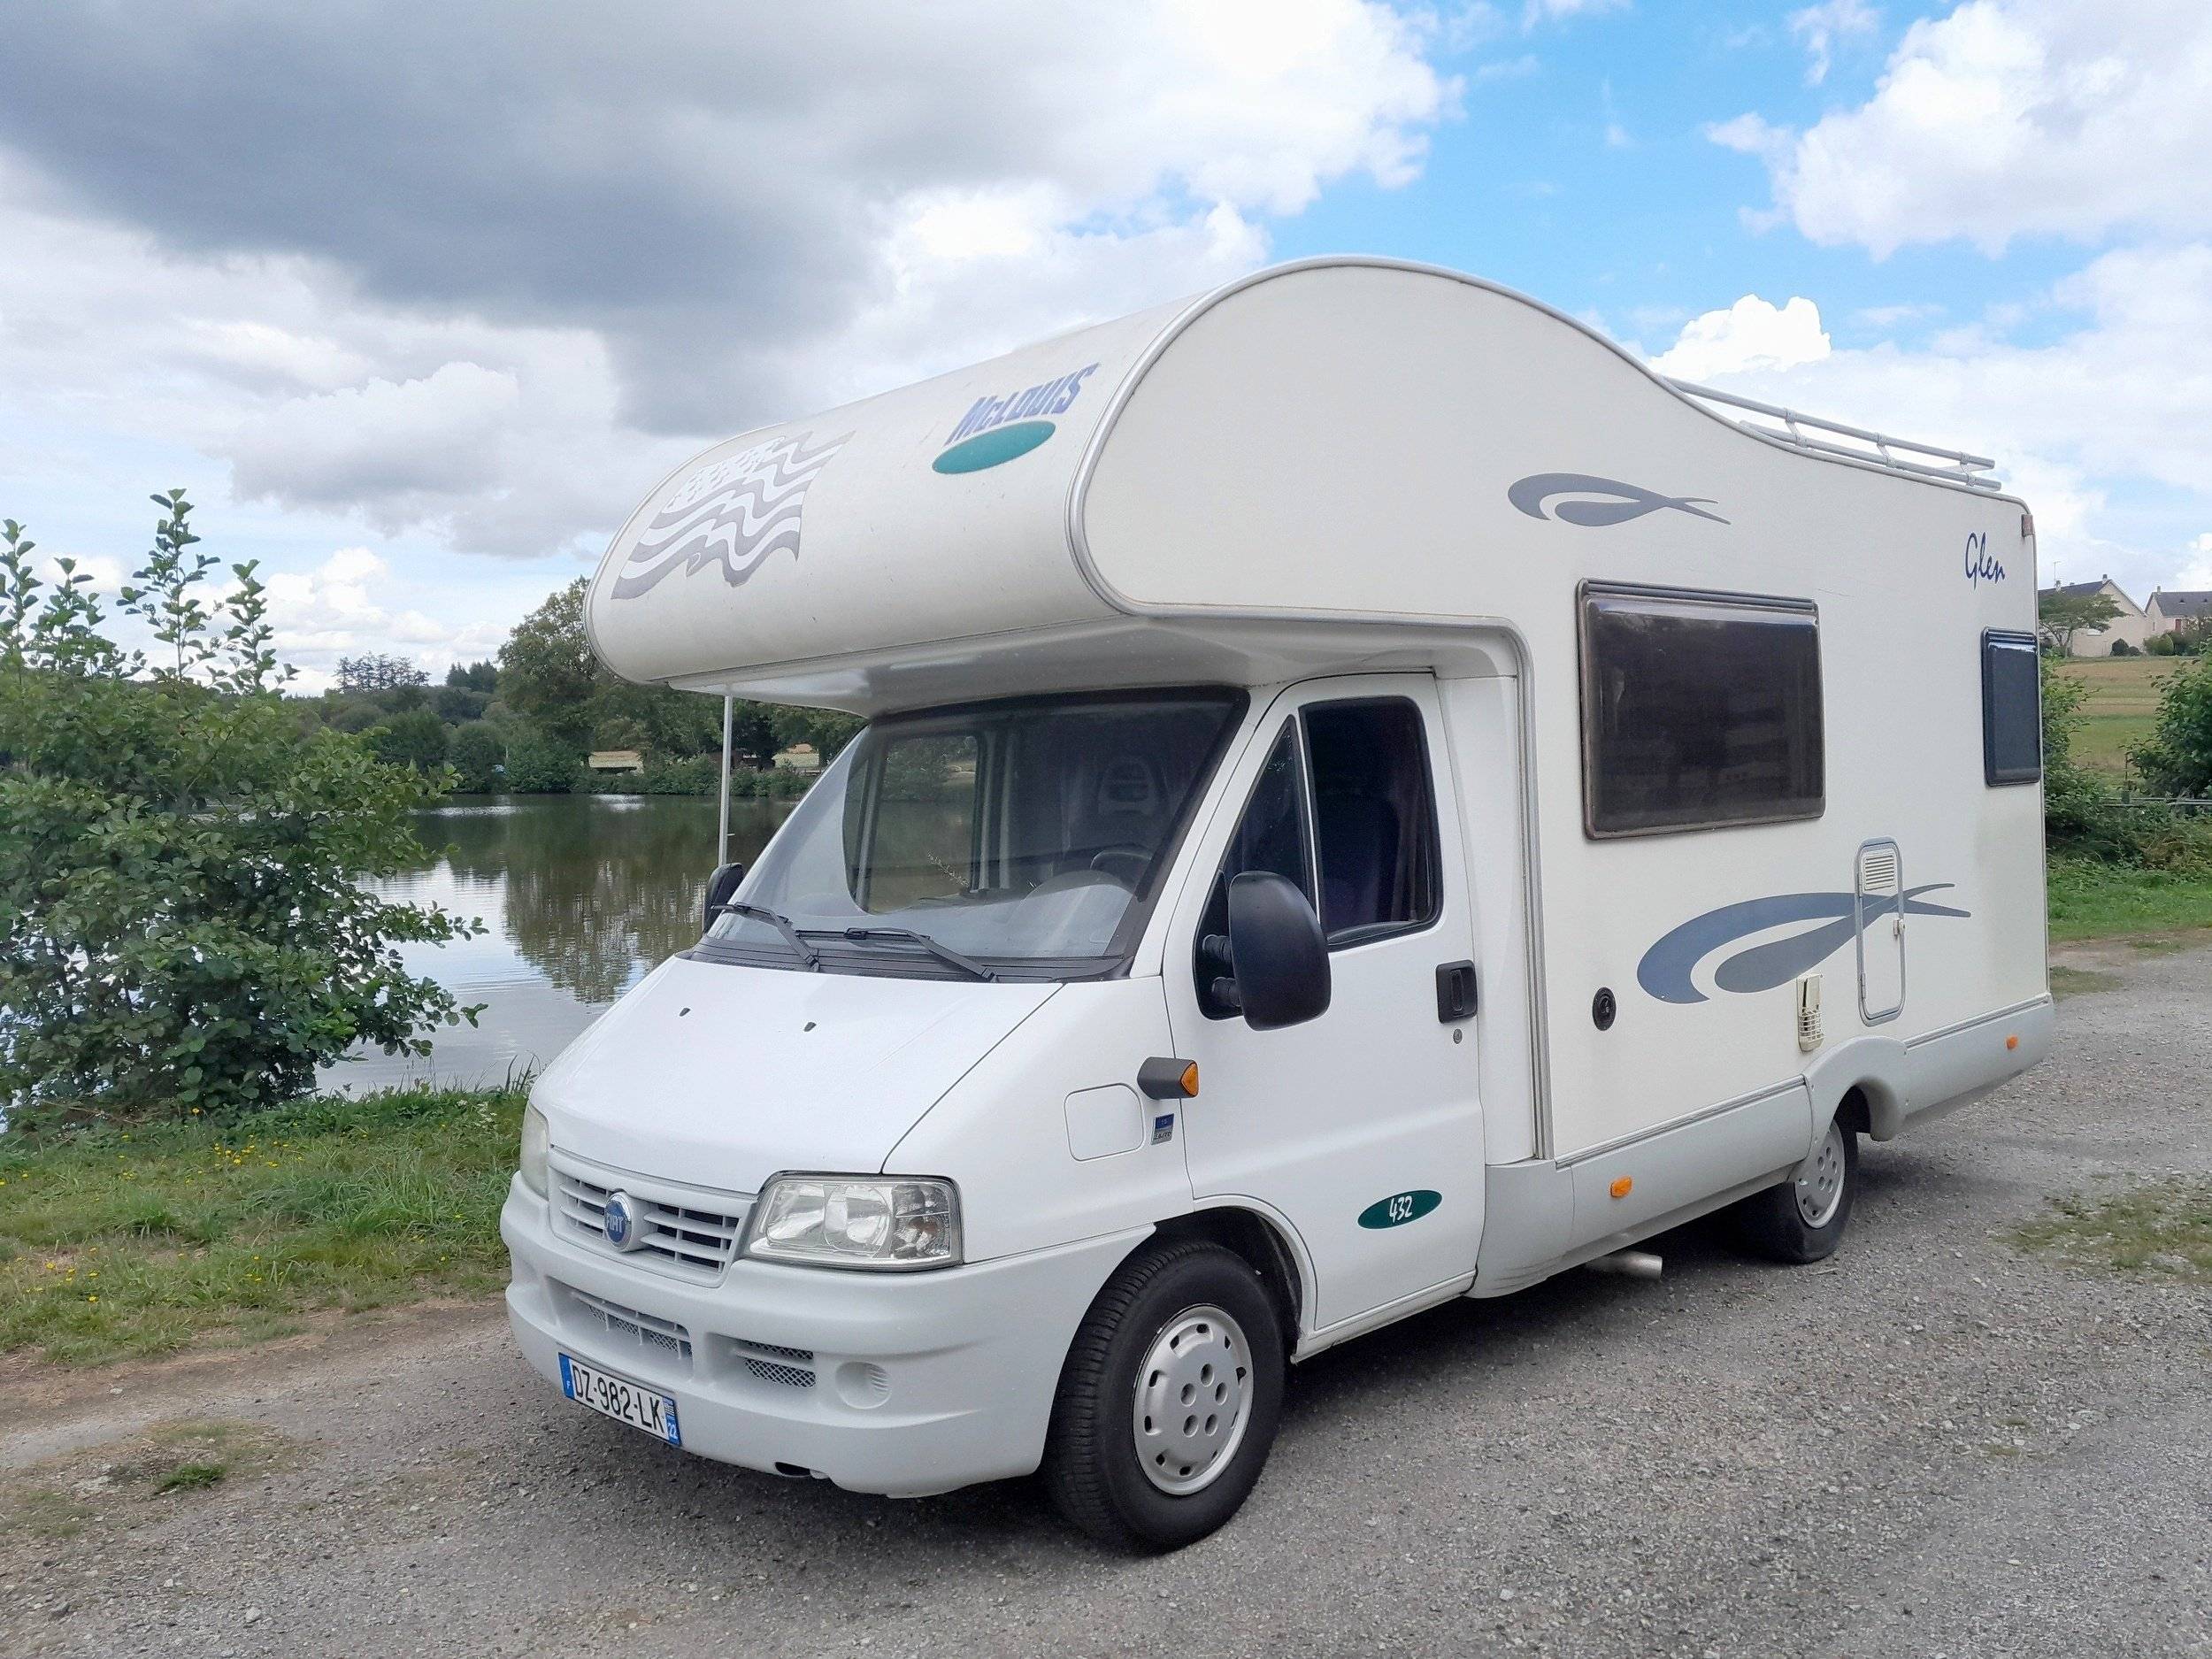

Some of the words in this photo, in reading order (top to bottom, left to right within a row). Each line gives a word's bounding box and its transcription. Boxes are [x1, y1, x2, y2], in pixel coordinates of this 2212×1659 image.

[1965, 532, 2005, 590] Glen
[1389, 1195, 1413, 1223] 432
[572, 1364, 665, 1434] DZ-982-LK
